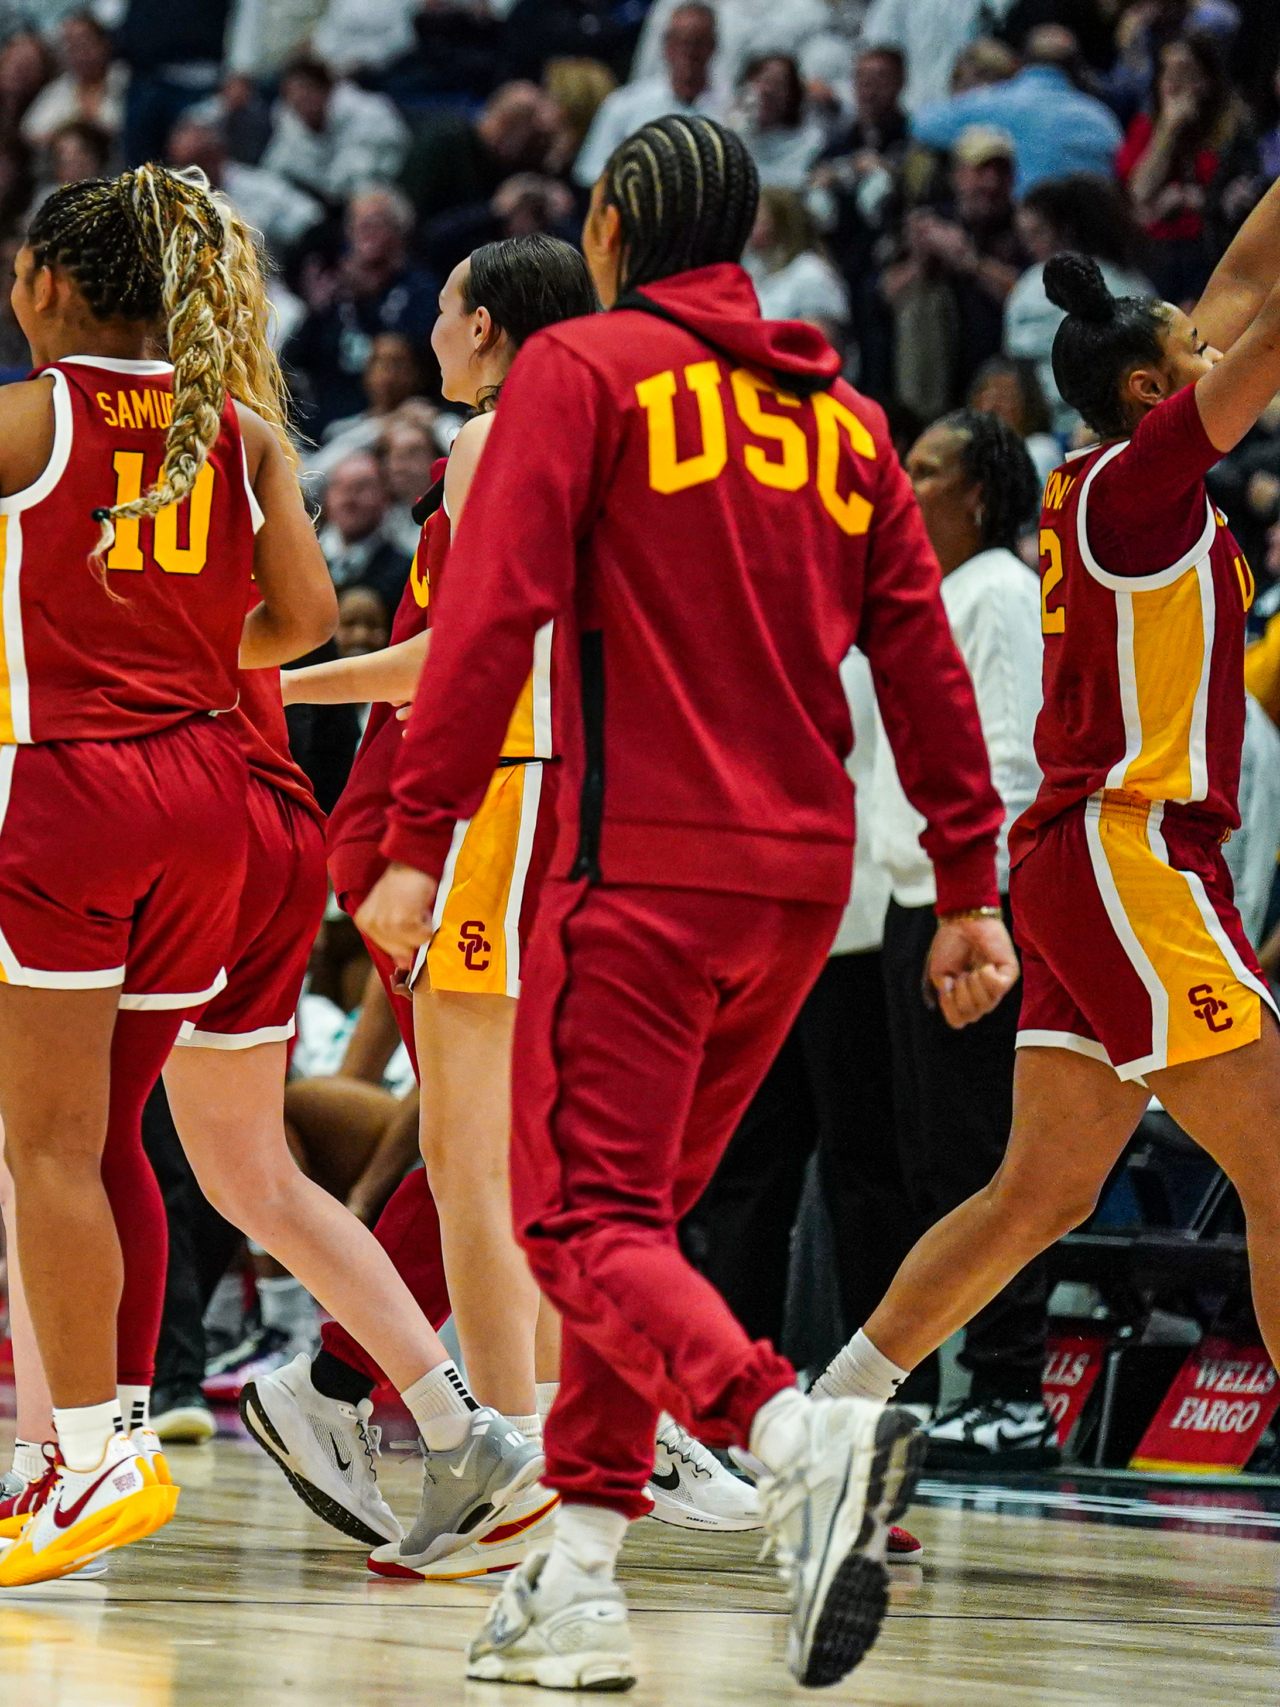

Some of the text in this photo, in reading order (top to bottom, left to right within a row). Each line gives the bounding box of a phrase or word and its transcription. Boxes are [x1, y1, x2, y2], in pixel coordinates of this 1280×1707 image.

[635, 360, 878, 536] USC
[106, 450, 216, 575] 10
[457, 920, 492, 971] SC
[1187, 983, 1234, 1033] SC
[1195, 1360, 1278, 1394] WELLS
[1170, 1396, 1261, 1434] FARGO
